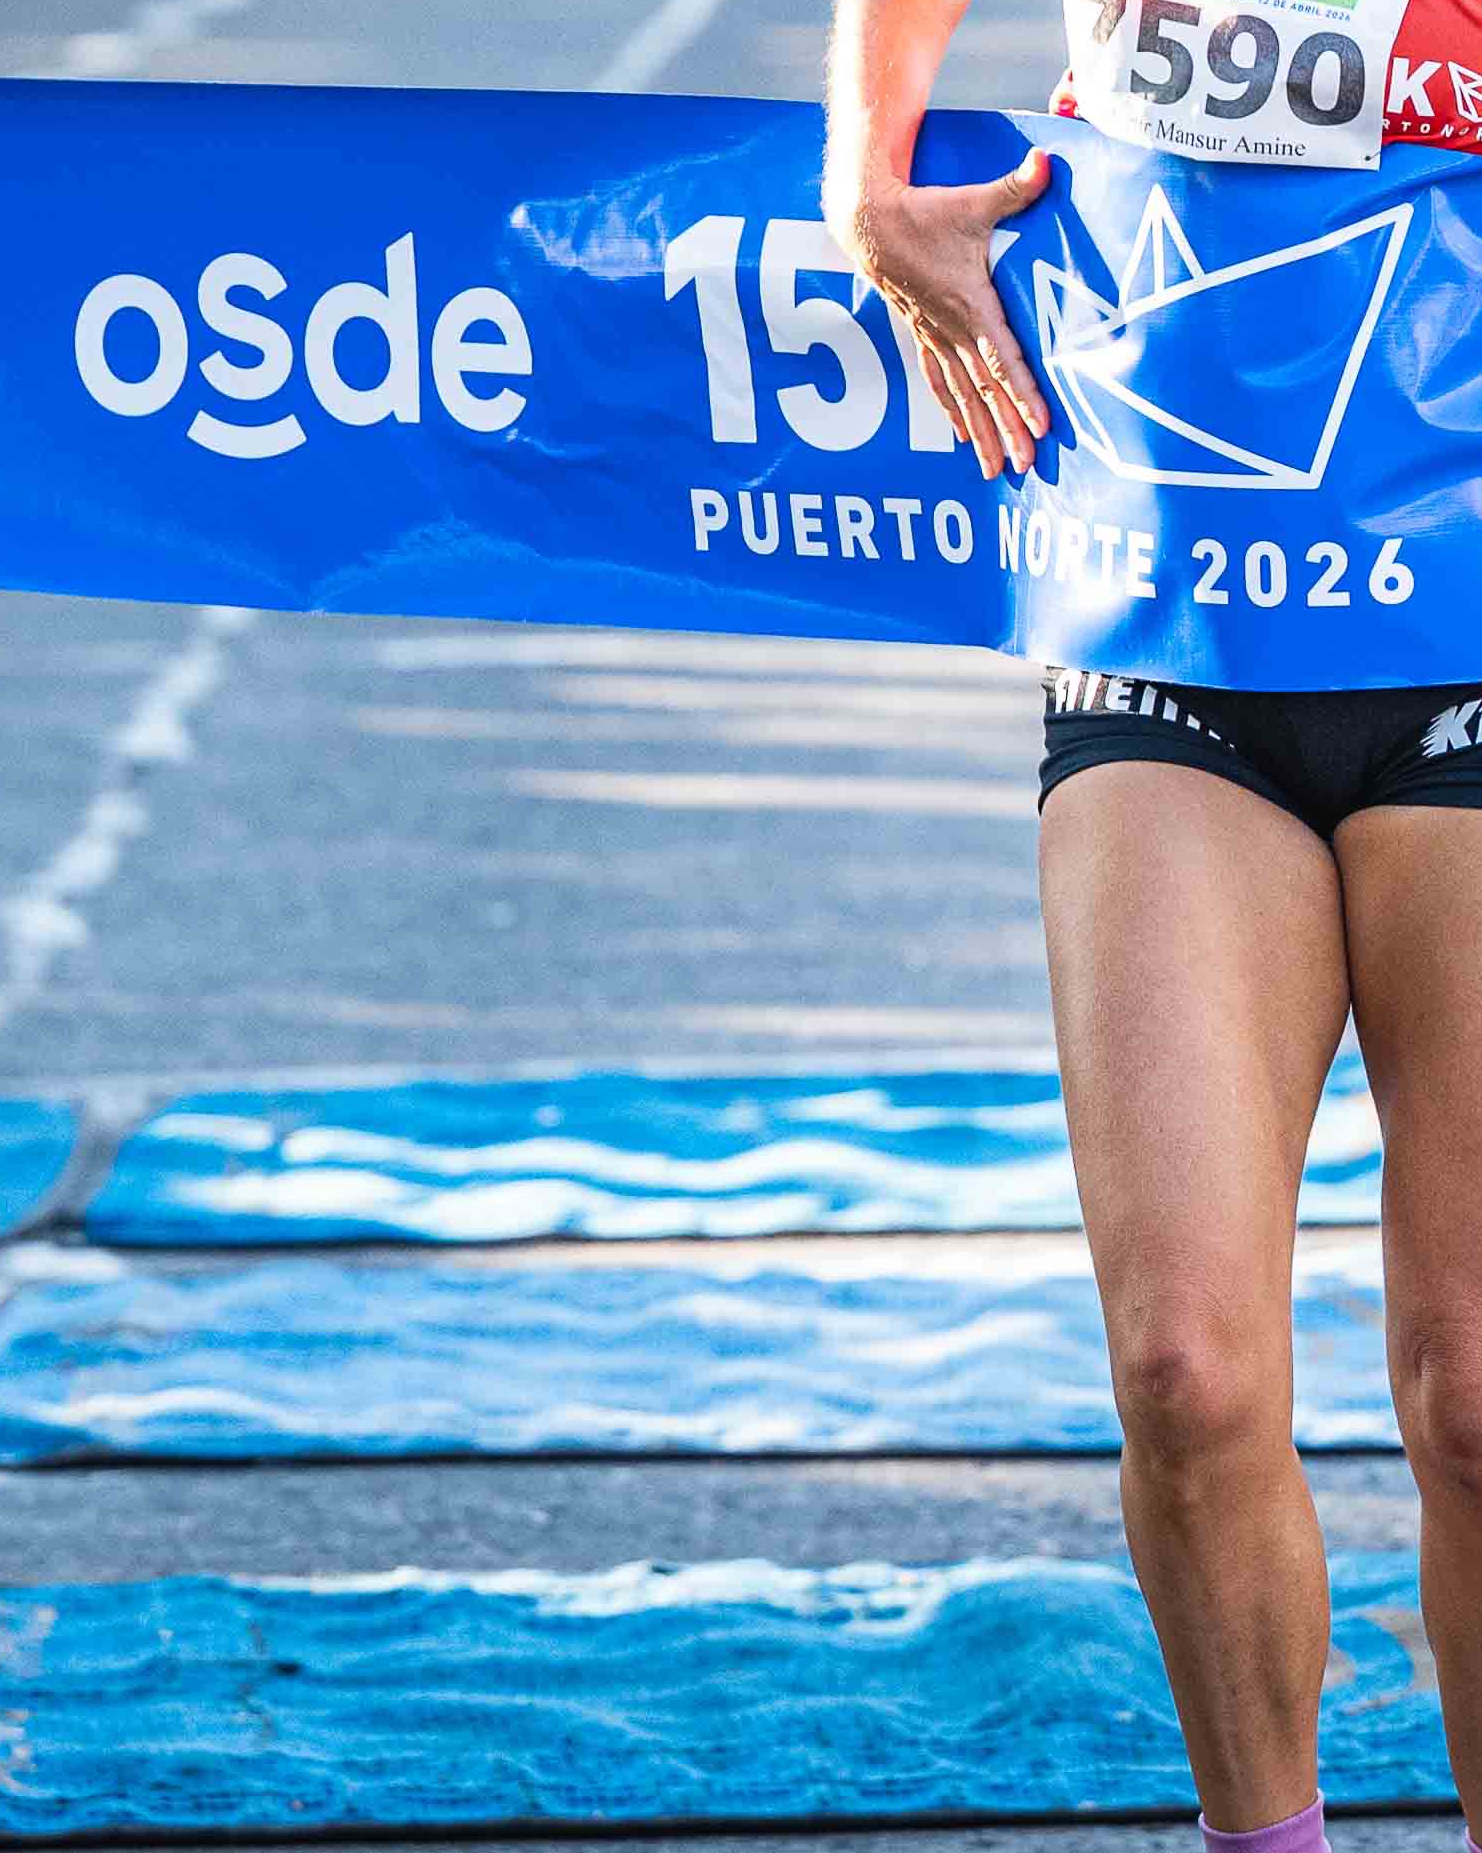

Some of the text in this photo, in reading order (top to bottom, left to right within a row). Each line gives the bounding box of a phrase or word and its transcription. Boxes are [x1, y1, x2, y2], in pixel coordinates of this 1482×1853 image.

[1155, 118, 1227, 152] Mansur
[1233, 135, 1306, 158] Amine
[74, 230, 534, 433] osde
[690, 487, 1416, 609] PUERTO NORTE 2026
